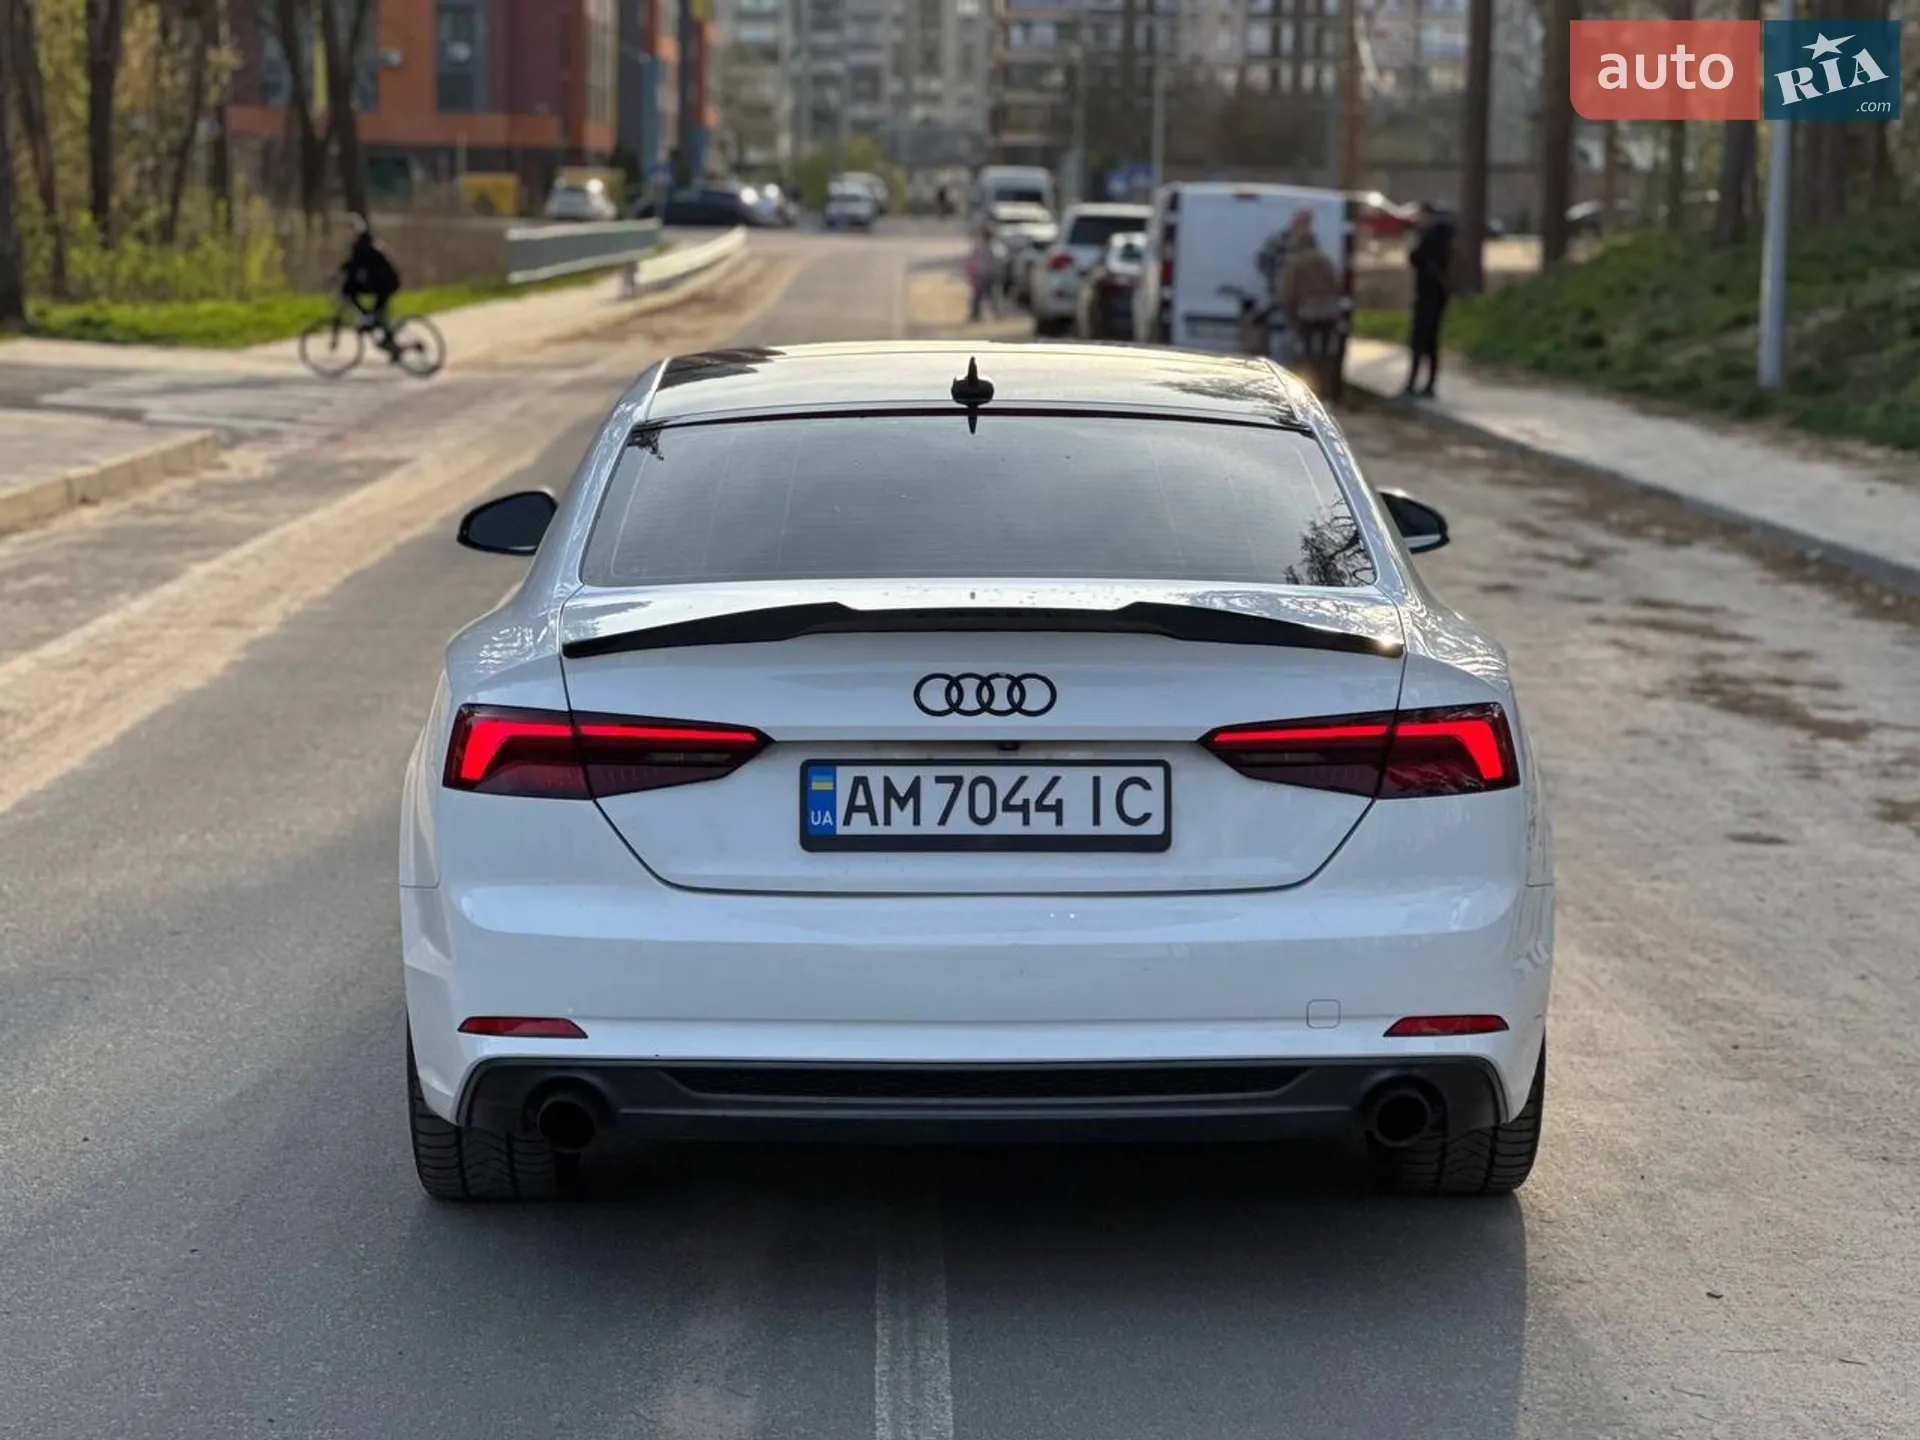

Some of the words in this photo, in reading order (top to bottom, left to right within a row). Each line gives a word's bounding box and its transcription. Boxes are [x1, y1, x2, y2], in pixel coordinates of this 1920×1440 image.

[843, 775, 922, 827] AM
[935, 775, 1063, 827] 7044
[1092, 775, 1153, 827] IC
[811, 811, 834, 826] UA
